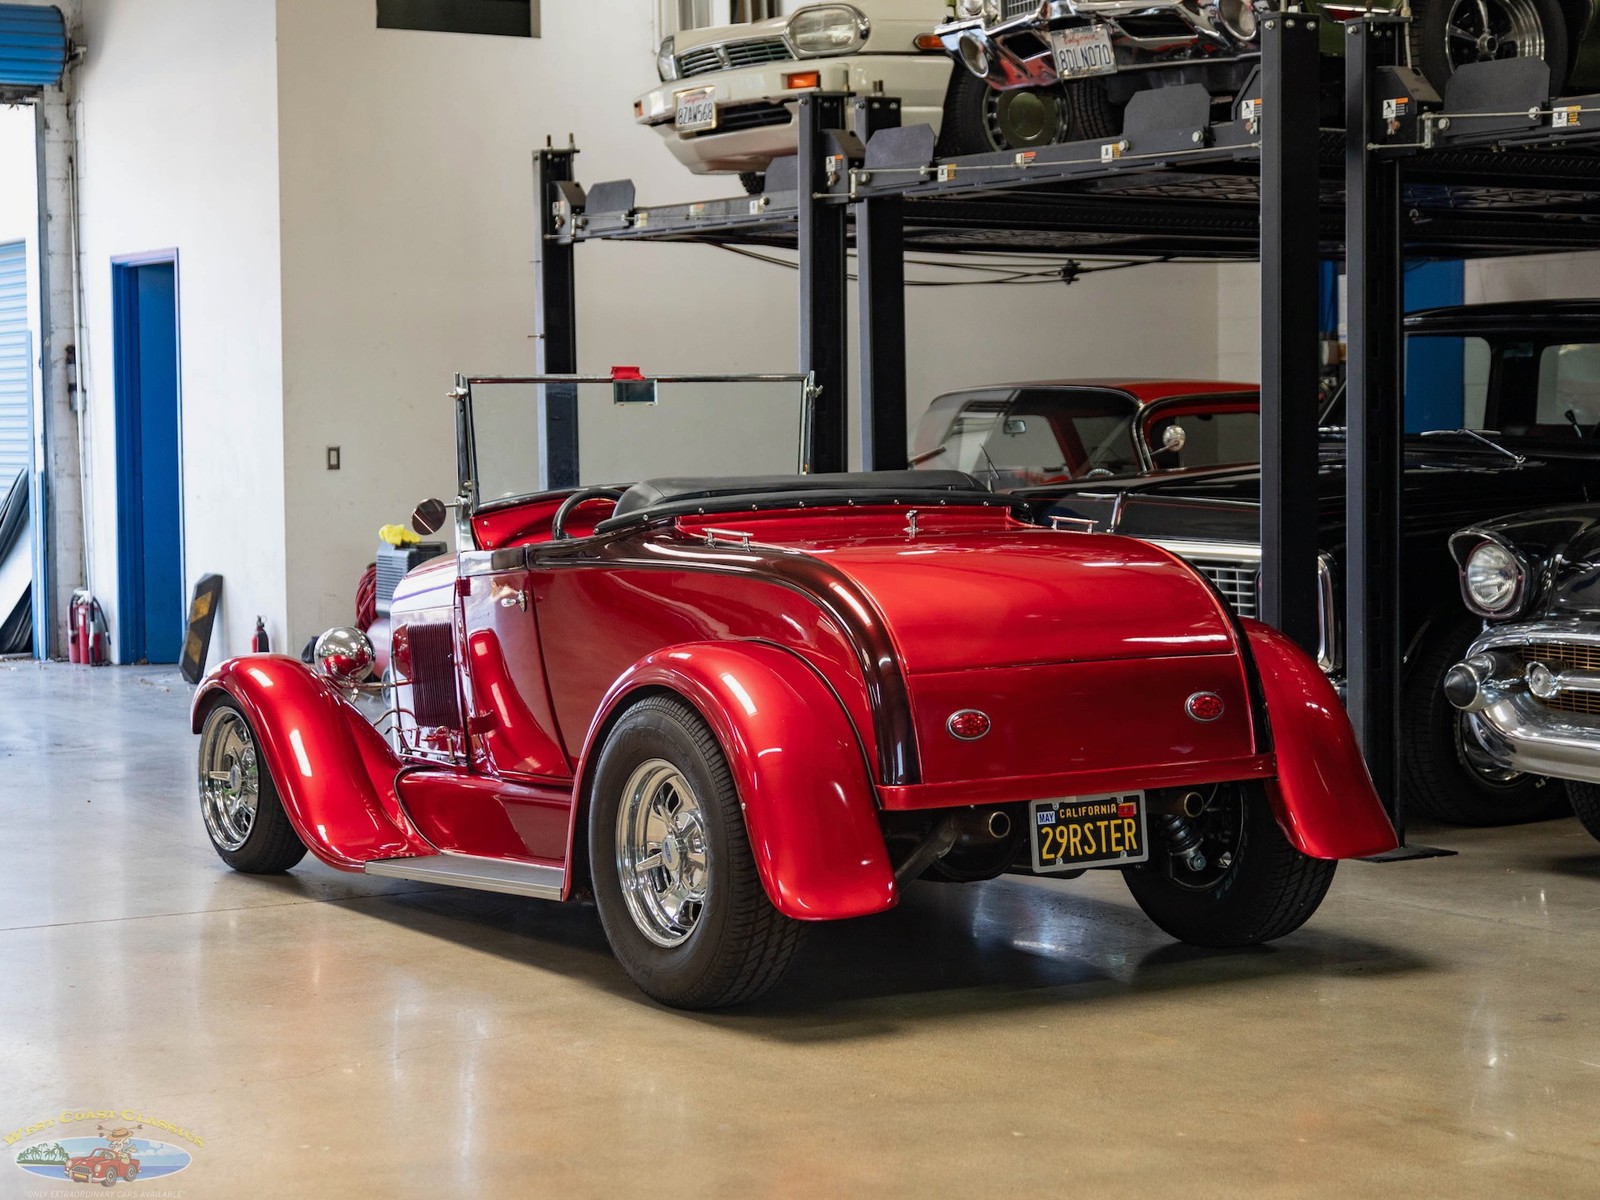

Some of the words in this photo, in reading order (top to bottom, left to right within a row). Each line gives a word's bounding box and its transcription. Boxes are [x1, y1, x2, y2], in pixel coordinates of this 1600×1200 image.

[1058, 43, 1112, 72] 8DLN070
[1038, 811, 1055, 824] MAY
[1059, 803, 1117, 819] CALIFORNIA
[1041, 818, 1138, 860] 29RSTER
